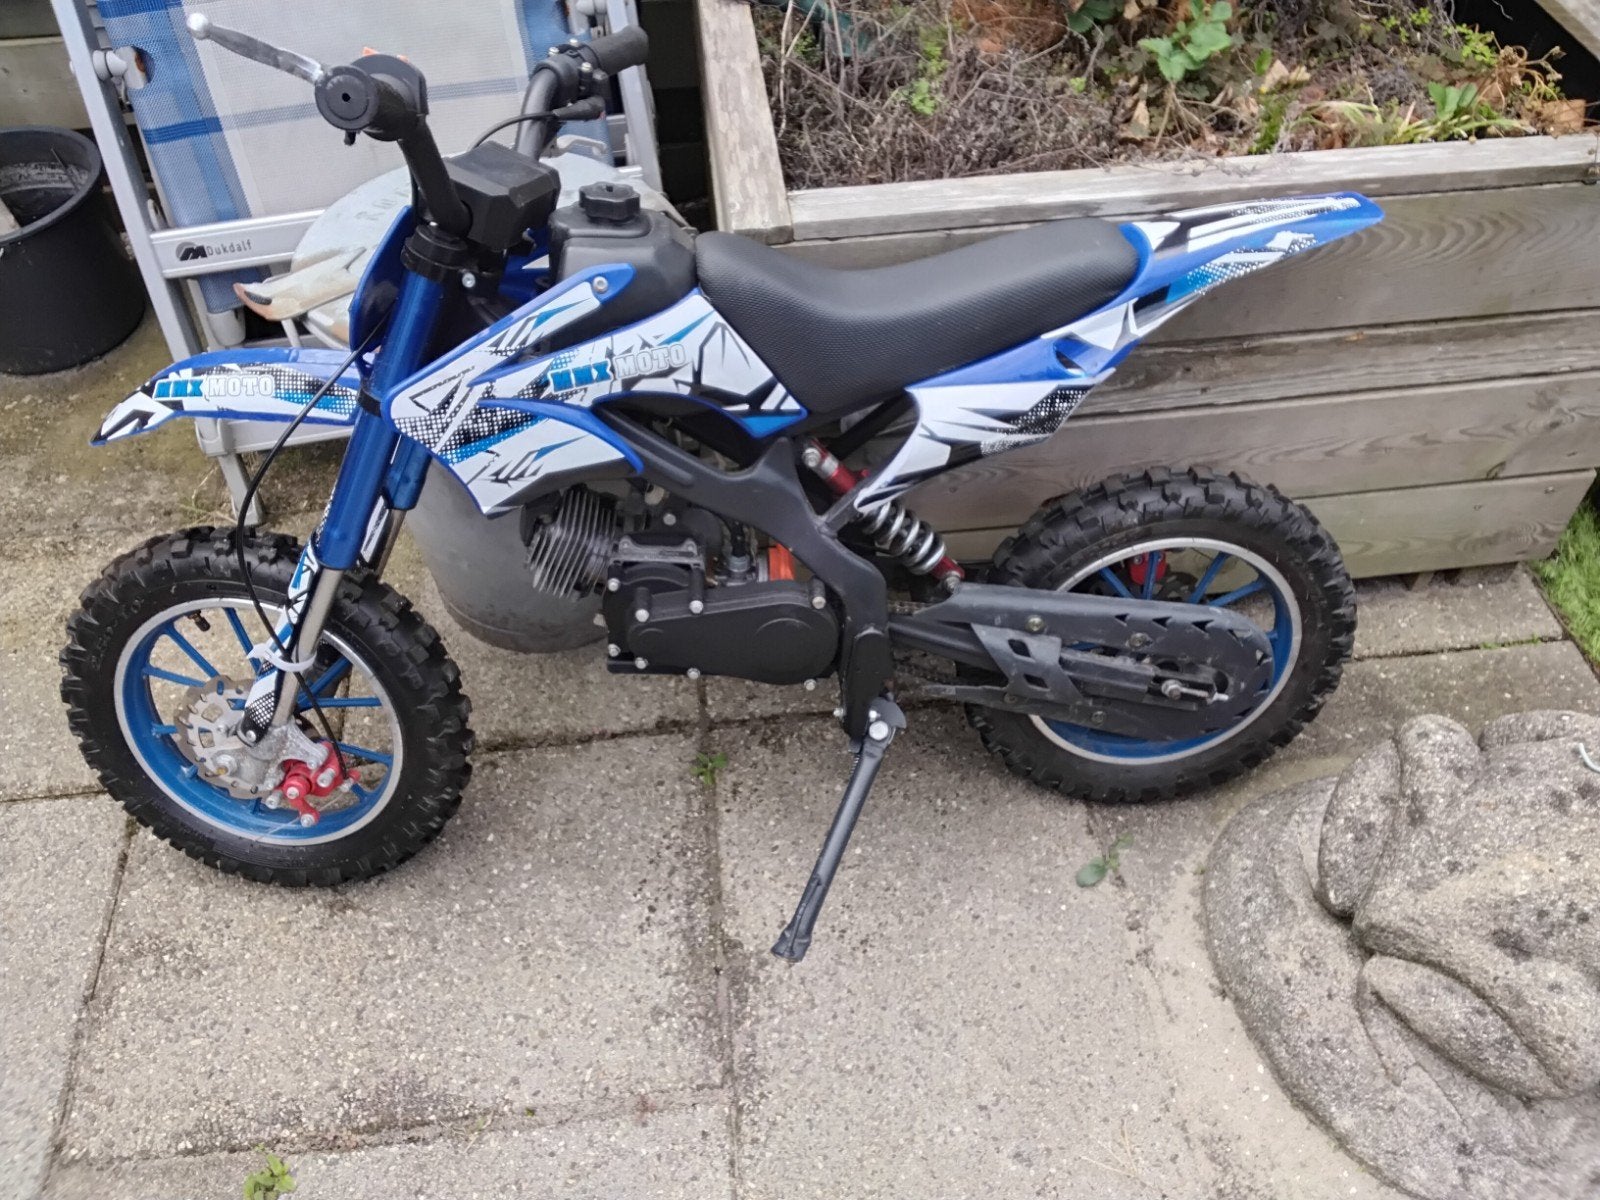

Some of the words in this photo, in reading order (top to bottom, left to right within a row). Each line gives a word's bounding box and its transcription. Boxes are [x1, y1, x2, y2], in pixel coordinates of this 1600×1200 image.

[207, 240, 252, 256] Dukdalf
[614, 343, 686, 378] MOTO
[208, 375, 274, 398] MOTO
